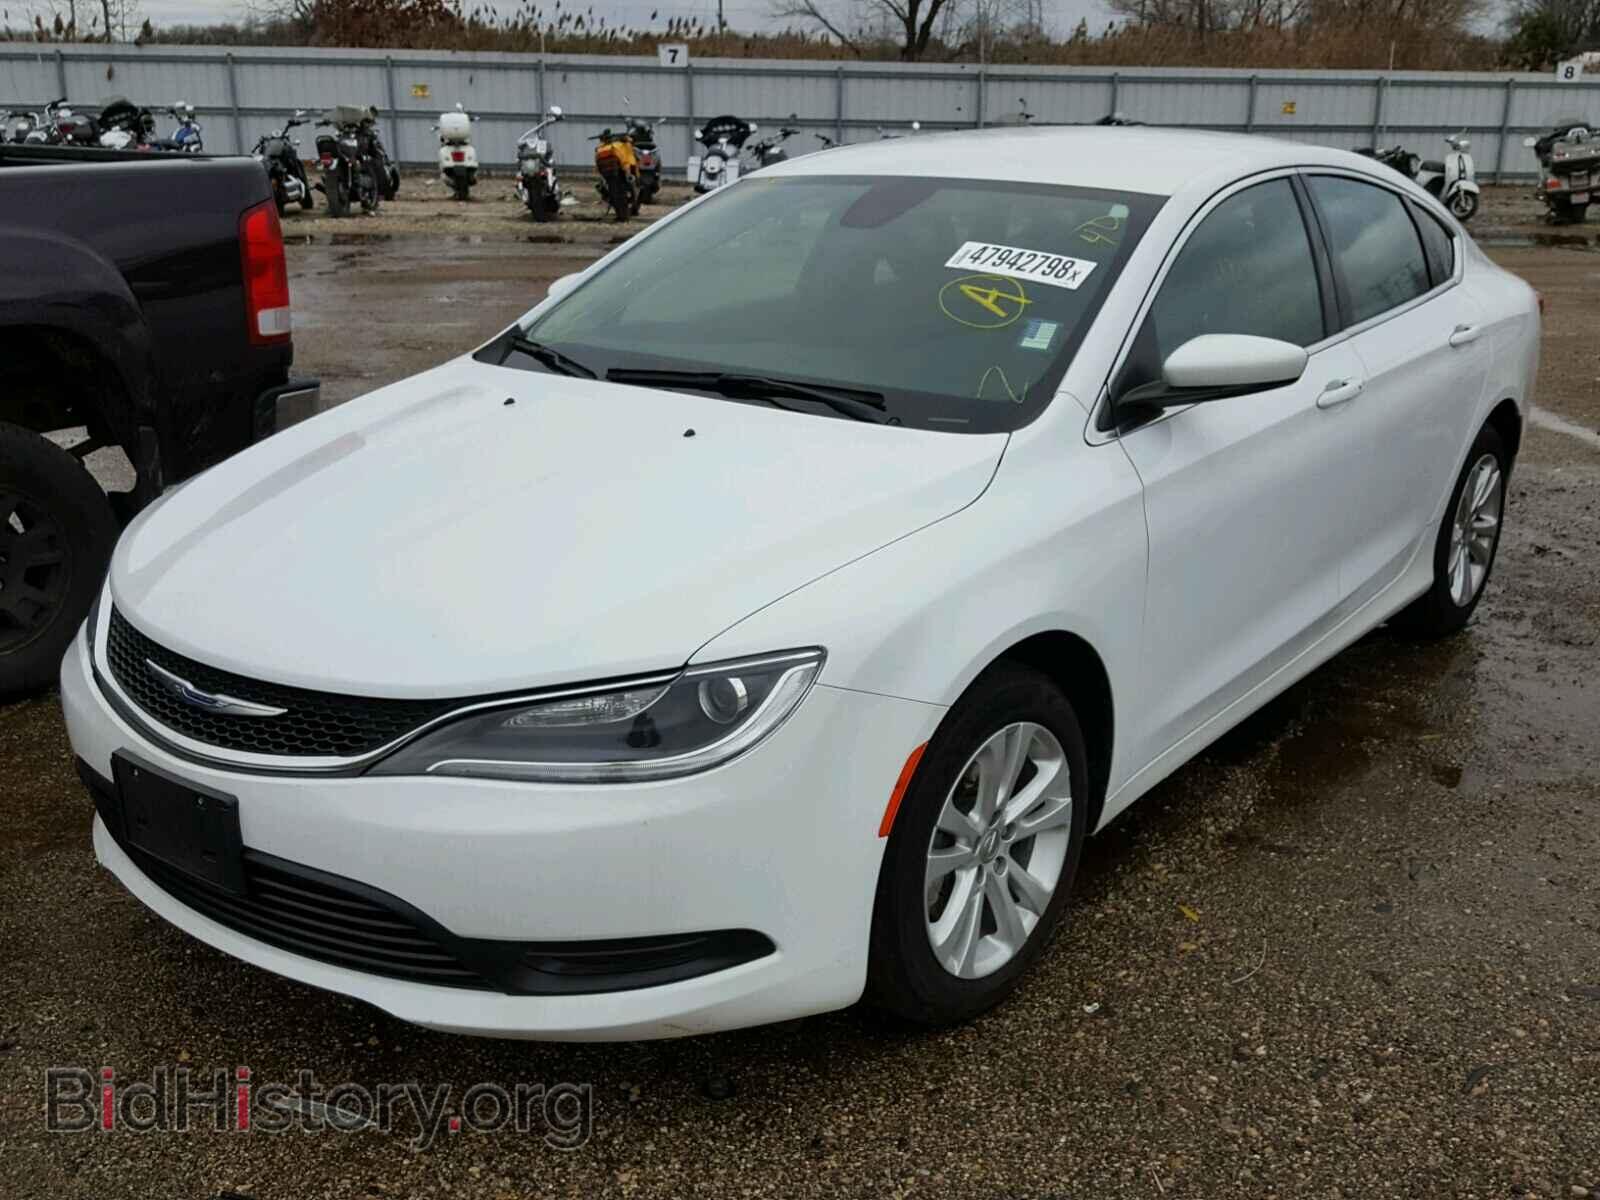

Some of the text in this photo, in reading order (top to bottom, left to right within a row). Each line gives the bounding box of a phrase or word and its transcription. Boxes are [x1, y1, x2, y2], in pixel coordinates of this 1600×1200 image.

[668, 48, 679, 64] 7
[1564, 65, 1575, 80] 8
[968, 245, 1076, 279] 47942798
[959, 284, 1033, 318] A
